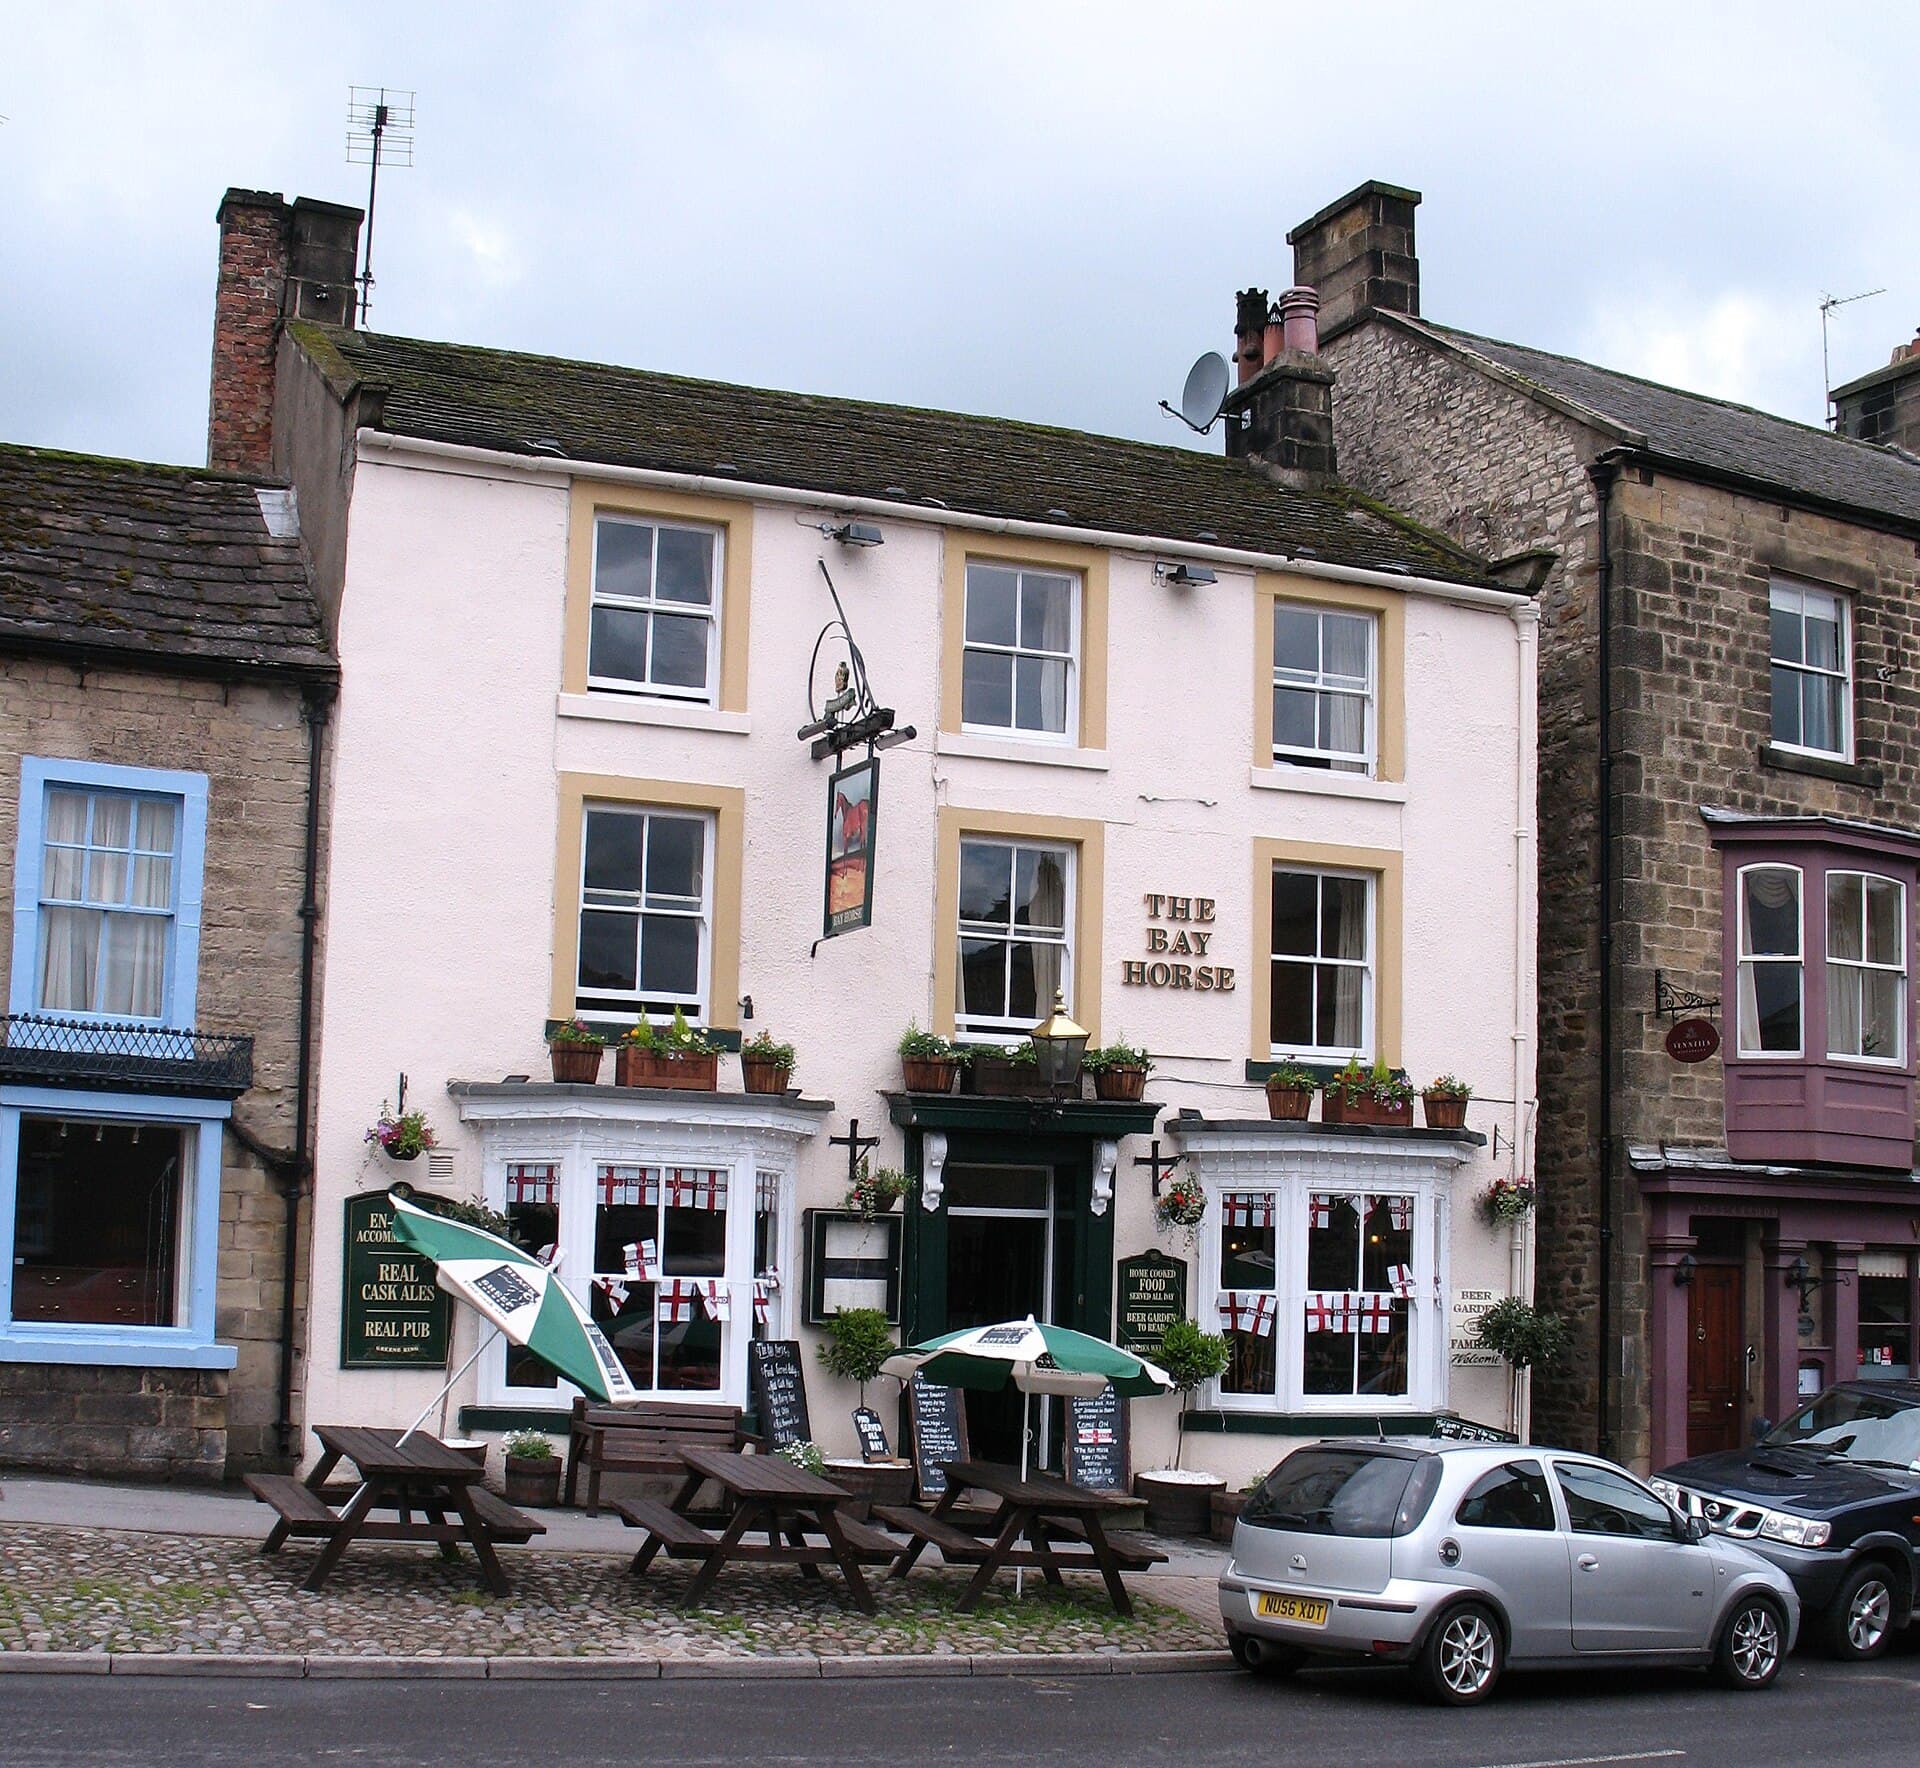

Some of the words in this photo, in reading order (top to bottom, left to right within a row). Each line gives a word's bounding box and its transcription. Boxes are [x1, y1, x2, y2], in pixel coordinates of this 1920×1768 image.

[1144, 893, 1216, 921] THE
[1146, 928, 1213, 956] BAY
[1122, 960, 1236, 991] HORSE
[697, 1183, 726, 1191] ENGLAND
[378, 1264, 419, 1283] REAL
[1129, 1268, 1149, 1278] HOME
[1149, 1269, 1177, 1278] COOKED
[1139, 1279, 1166, 1291] FOOD
[362, 1284, 398, 1301] CASK
[400, 1285, 435, 1302] ALES
[1129, 1292, 1152, 1300] SERVED
[1152, 1292, 1163, 1301] ALL
[1163, 1293, 1175, 1301] DAY
[1461, 1291, 1492, 1300] BEER
[1126, 1312, 1146, 1322] BEER
[1147, 1313, 1177, 1323] GARDEN
[365, 1321, 399, 1337] REAL
[402, 1322, 431, 1338] PUB
[1137, 1323, 1146, 1332] TO
[376, 1345, 401, 1353] GREENE
[1451, 1352, 1501, 1365] Welcome
[860, 1423, 882, 1433] SERVED
[868, 1432, 880, 1440] ALL
[869, 1440, 884, 1451] DAY
[1264, 1597, 1297, 1616] NU56
[1298, 1601, 1324, 1621] XDT
